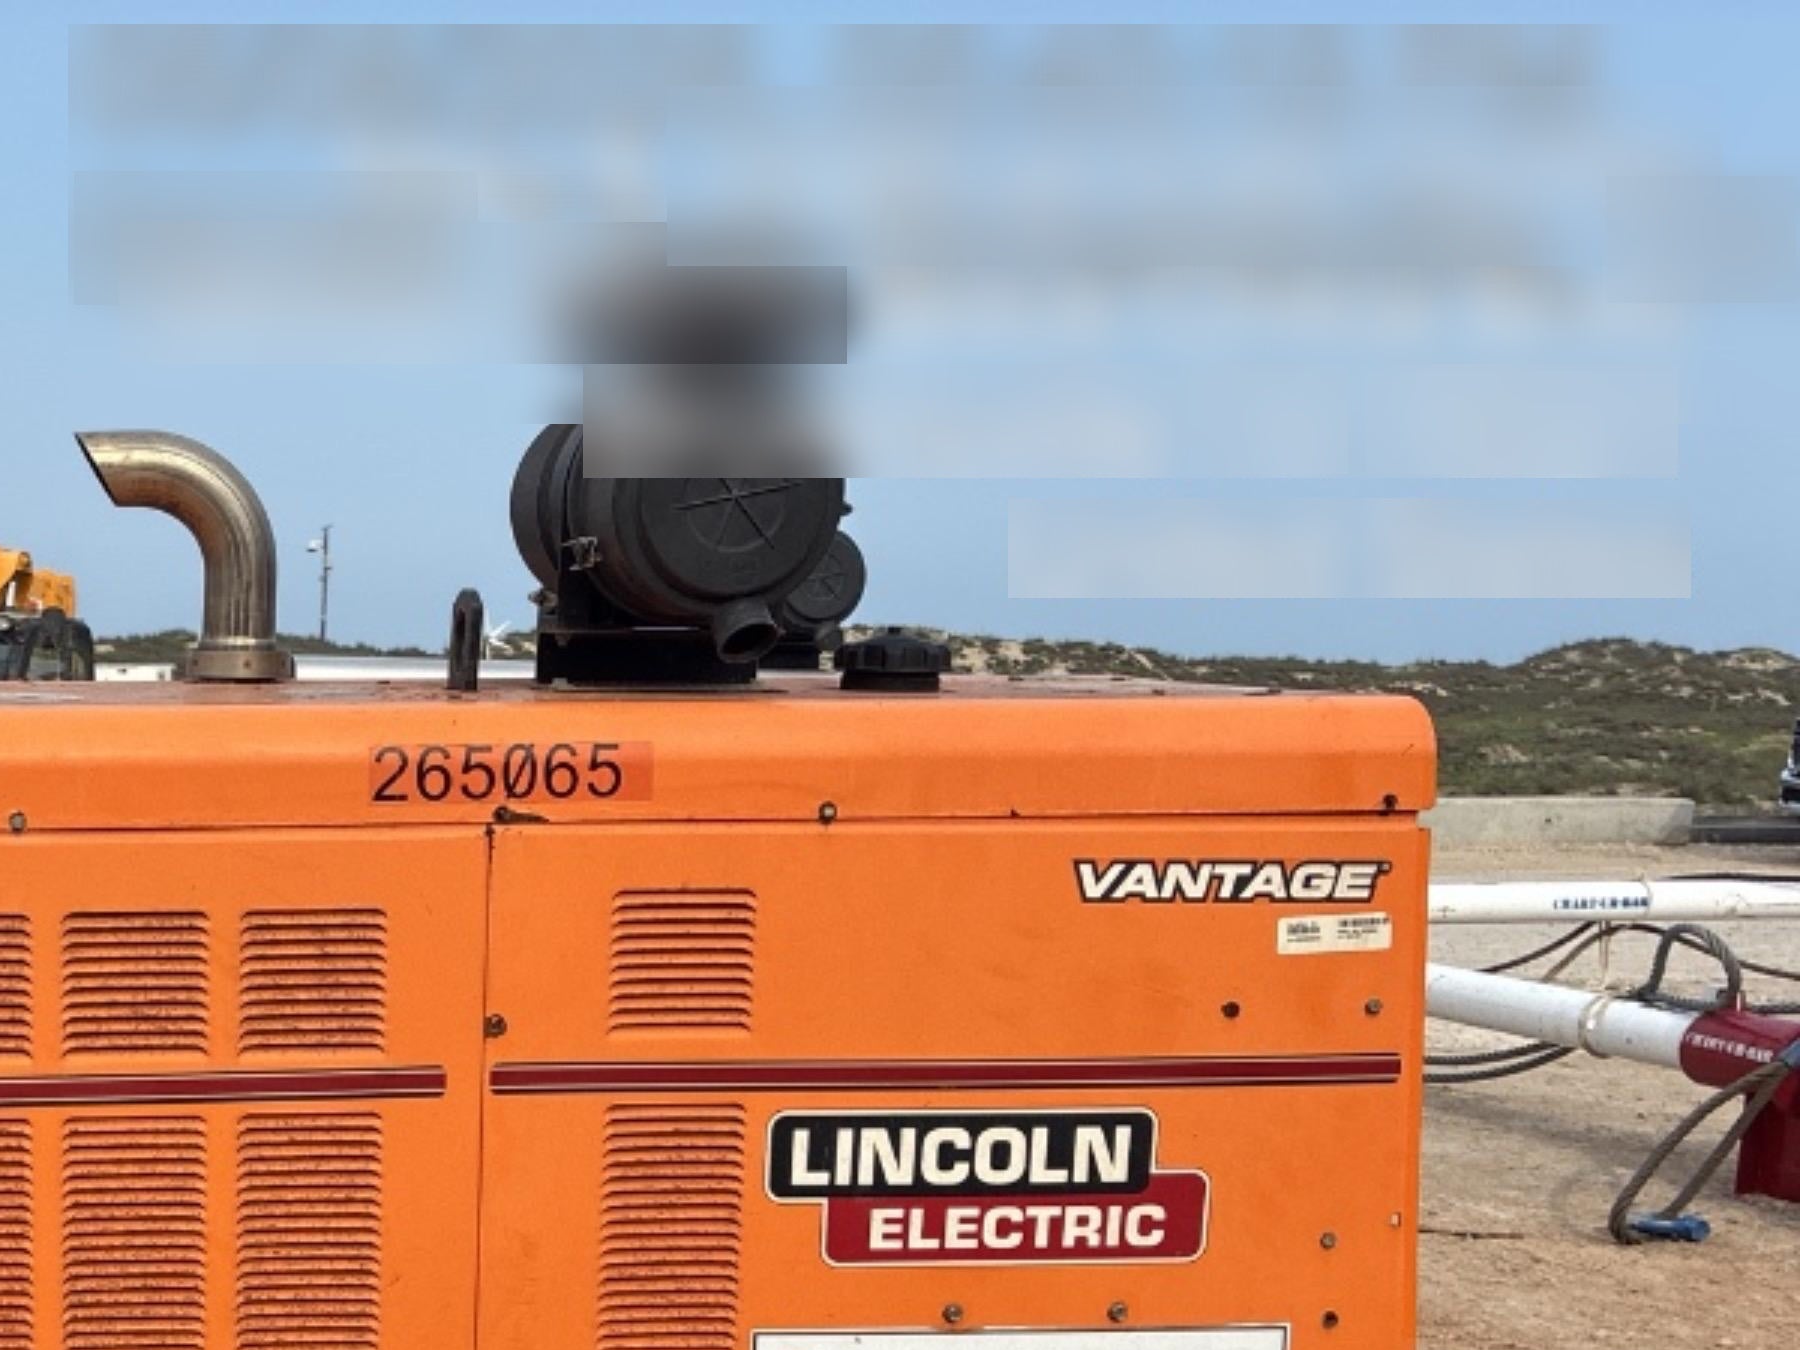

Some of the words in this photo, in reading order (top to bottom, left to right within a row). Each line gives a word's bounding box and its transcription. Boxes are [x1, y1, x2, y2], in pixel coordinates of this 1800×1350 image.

[371, 742, 622, 802] 265065
[1073, 859, 1382, 903] VANTAGE
[789, 1124, 1133, 1187] LINCOLN
[867, 1204, 1167, 1252] ELECTRIC
